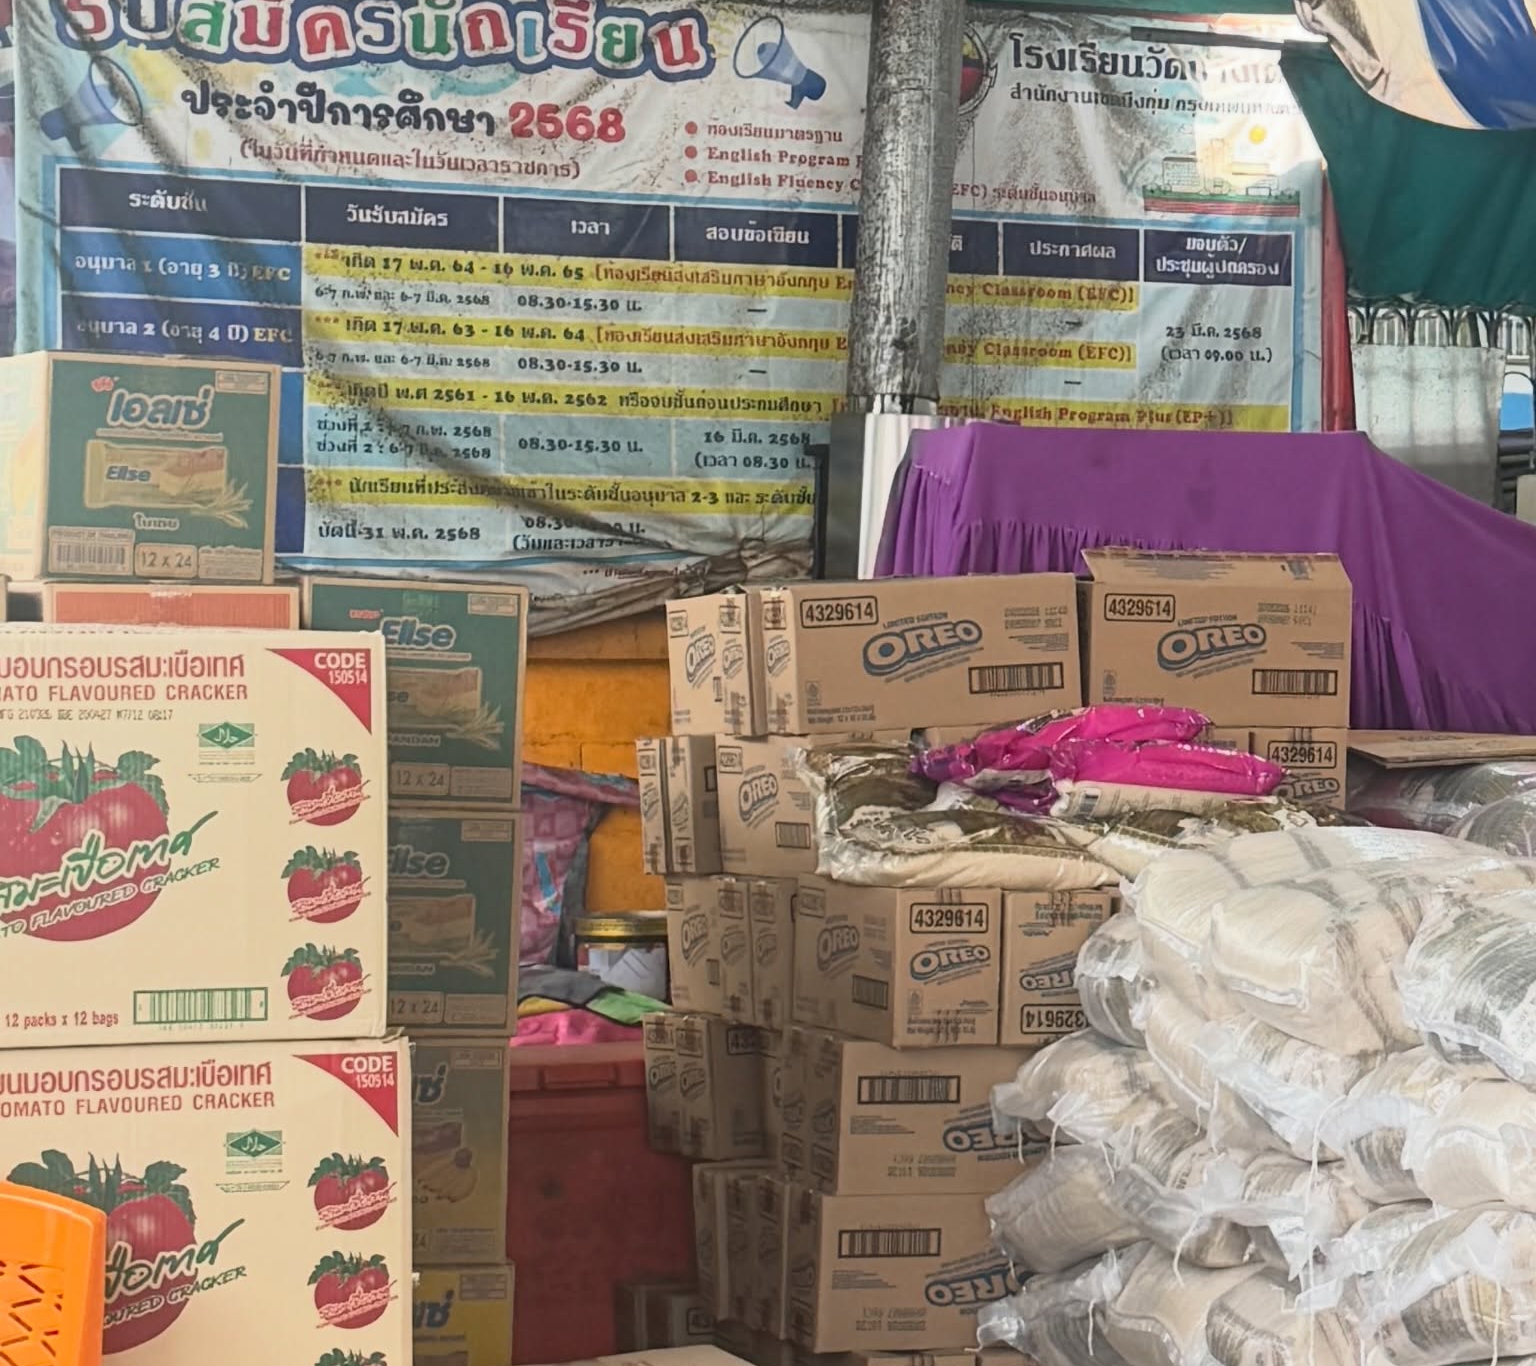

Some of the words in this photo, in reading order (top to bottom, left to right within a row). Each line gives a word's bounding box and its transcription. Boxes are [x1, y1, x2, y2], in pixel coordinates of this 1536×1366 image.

[182, 79, 496, 137] ประจำปีการศึกษา
[508, 101, 626, 143] 2568
[707, 146, 772, 163] English
[778, 150, 850, 168] Program
[707, 170, 772, 187] English
[777, 174, 843, 192] Fluency
[346, 203, 449, 227] วันรับสมัคร
[570, 218, 610, 237] เวลา
[705, 220, 810, 245] สอบข้อเขียน
[1029, 240, 1117, 260] ประกาศผล
[208, 264, 221, 279] 3
[382, 256, 402, 273] 17
[453, 260, 475, 275] 64
[563, 265, 585, 281] 65
[457, 293, 491, 306] 2568
[517, 293, 621, 313] 08.30-15.30
[143, 322, 155, 336] 2
[208, 326, 220, 342] 4
[382, 319, 403, 336] 17
[453, 323, 476, 338] 63
[495, 325, 515, 339] 16
[563, 328, 586, 343] 64
[1223, 326, 1262, 339] 2568
[457, 357, 491, 369] 2568
[517, 357, 621, 374] 08.30-15.30
[107, 385, 215, 429] เอลเซ่
[433, 387, 475, 402] 2561
[495, 391, 515, 405] 16
[564, 393, 608, 407] 2562
[1057, 406, 1131, 425] Program
[453, 425, 492, 437] 2568
[517, 436, 621, 453] 08.30-15.30
[704, 430, 725, 444] 16
[742, 455, 790, 469] 08.30
[435, 527, 481, 542] 2568
[141, 550, 158, 568] 12
[175, 552, 193, 569] 24
[804, 601, 875, 622] 4329614
[1108, 598, 1171, 617] 4329614
[864, 620, 982, 675] OREO
[1157, 623, 1267, 671] OREO
[314, 652, 367, 671] CODE
[327, 669, 368, 686] 150514
[49, 684, 156, 702] FLAVOURED
[166, 684, 248, 701] CRACKER
[1272, 745, 1333, 764] 4329614
[738, 773, 778, 822] OREO
[32, 885, 136, 930] FLAVOURED
[142, 858, 220, 894] CRACKER
[914, 908, 984, 928] 4329614
[816, 925, 860, 971] OREO
[910, 944, 991, 981] OREO
[5, 1011, 20, 1027] 12
[23, 1012, 57, 1030] packs
[73, 1011, 89, 1026] 12
[91, 1010, 119, 1029] bags
[341, 1054, 393, 1075] CODE
[355, 1072, 395, 1090] 150514
[1, 1099, 65, 1119] OMATO
[76, 1095, 183, 1116] FLAVOURED
[193, 1091, 275, 1111] CRACKER
[168, 1265, 247, 1304] CRACKER
